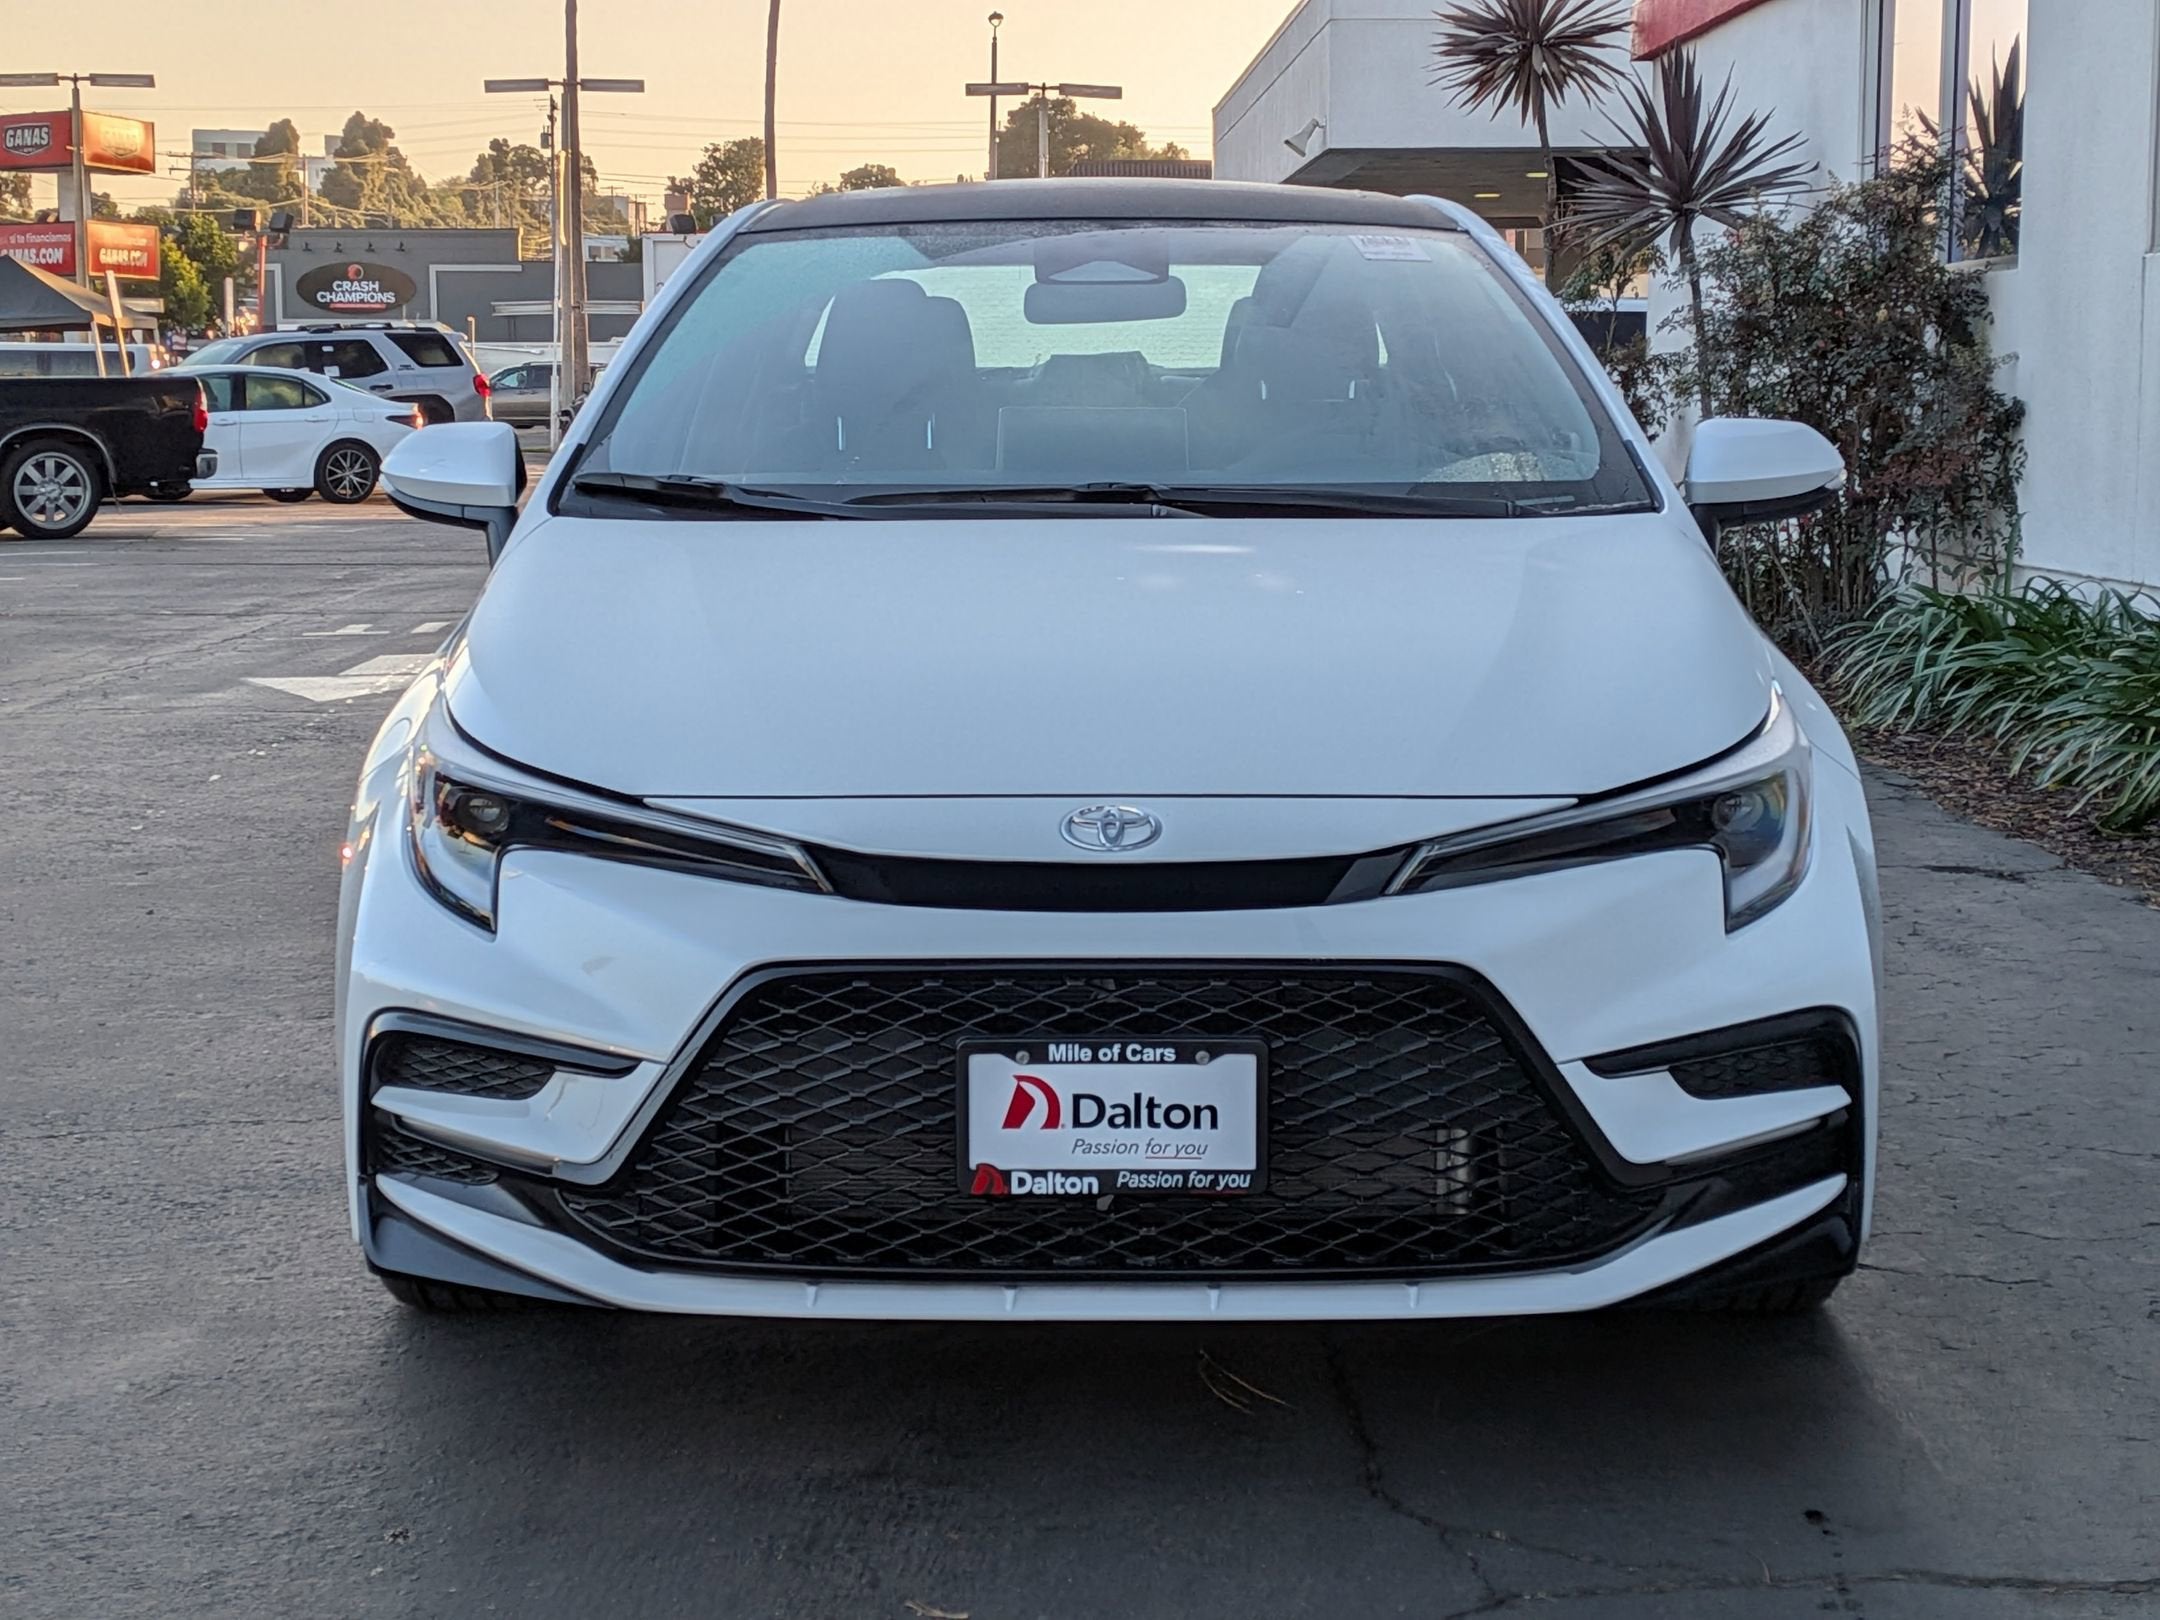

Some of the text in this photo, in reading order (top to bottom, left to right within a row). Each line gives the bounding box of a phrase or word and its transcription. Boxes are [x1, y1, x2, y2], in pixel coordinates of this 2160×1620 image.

[6, 127, 49, 147] GANAS
[332, 281, 379, 292] CRASH
[317, 291, 396, 303] CHAMPIONS
[1048, 1044, 1176, 1062] Mile of Cars
[1072, 1092, 1218, 1130] Dalton
[1072, 1138, 1208, 1159] Passion for you
[1010, 1171, 1251, 1195] Dalton Passion for you
